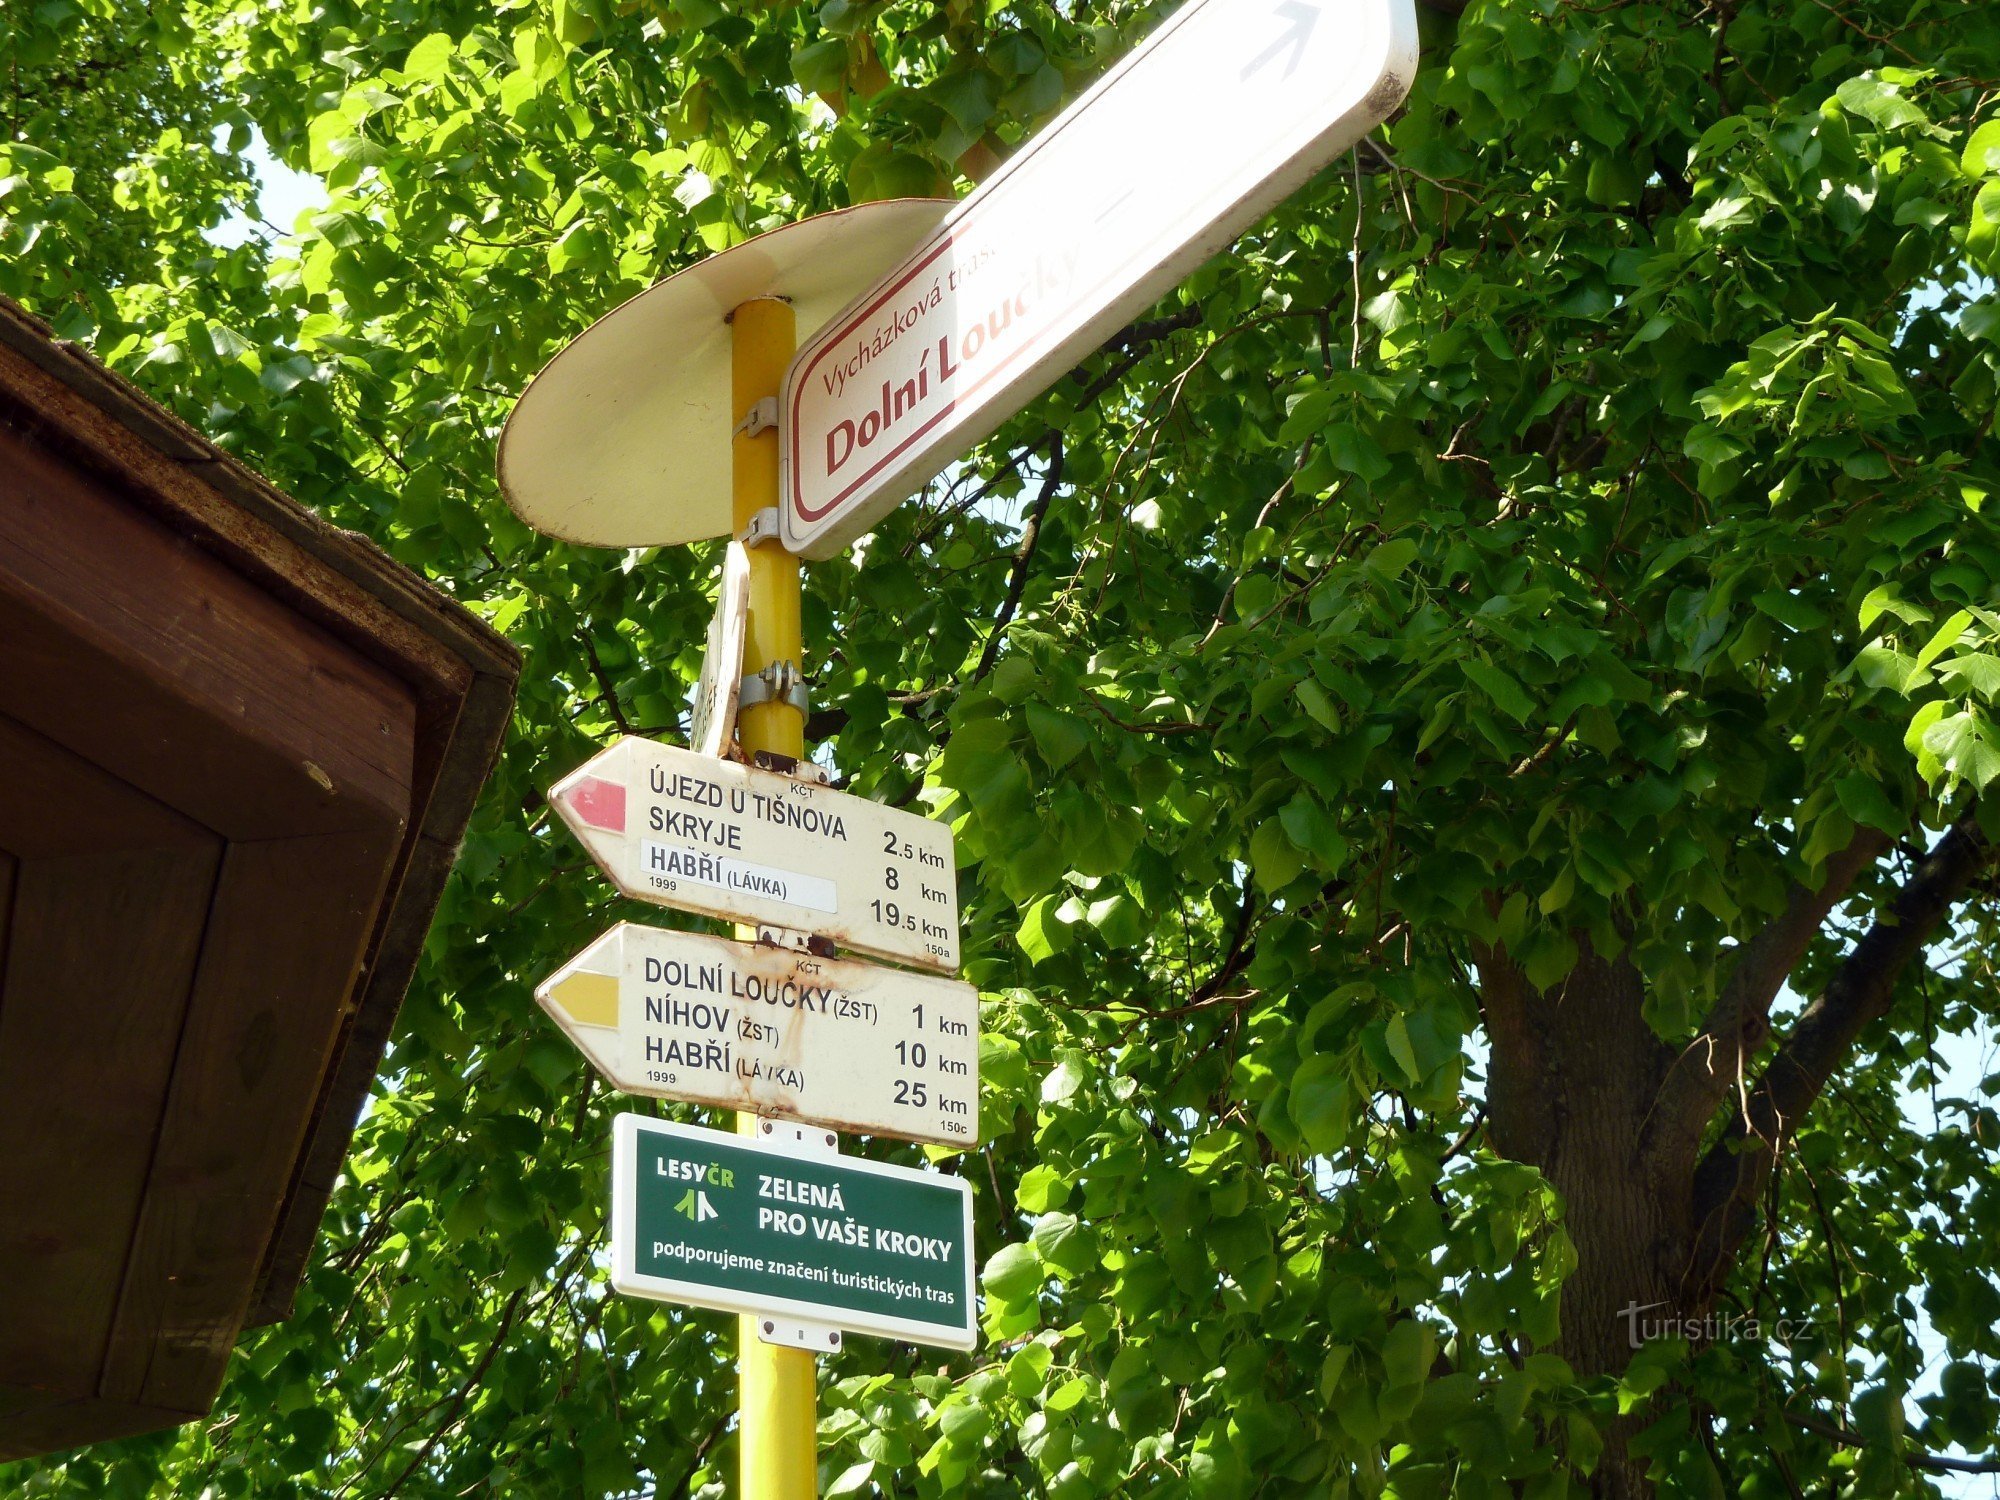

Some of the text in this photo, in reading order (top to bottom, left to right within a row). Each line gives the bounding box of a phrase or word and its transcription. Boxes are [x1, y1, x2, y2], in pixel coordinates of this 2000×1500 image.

[823, 277, 943, 398] Vycházková
[826, 348, 930, 478] Dolní
[650, 764, 847, 841] ÚJEZD U TIŠNOVA
[790, 783, 814, 799] KČT
[649, 806, 742, 850] SKRYJE
[651, 845, 788, 900] HABŘÍ (LÁVKA)
[919, 847, 945, 869] km
[649, 876, 677, 891] 1999
[885, 867, 947, 904] 8 km
[922, 919, 948, 940] km
[925, 943, 950, 958] 150a
[645, 957, 878, 1026] DOLNÍ LOUČKY (ŽST)
[645, 996, 779, 1048] NÍHOV (ŽST)
[911, 1004, 968, 1037] 1 km
[645, 1036, 731, 1073] HABŘÍ
[895, 1041, 968, 1076] 10 km
[646, 1070, 676, 1084] 1999
[894, 1080, 968, 1115] 25 km
[941, 1120, 968, 1135] 150c
[759, 1175, 845, 1212] ZELENÁ
[759, 1207, 953, 1262] PRO VAŠE KROKY
[653, 1240, 955, 1304] podporujeme značení turistických tras
